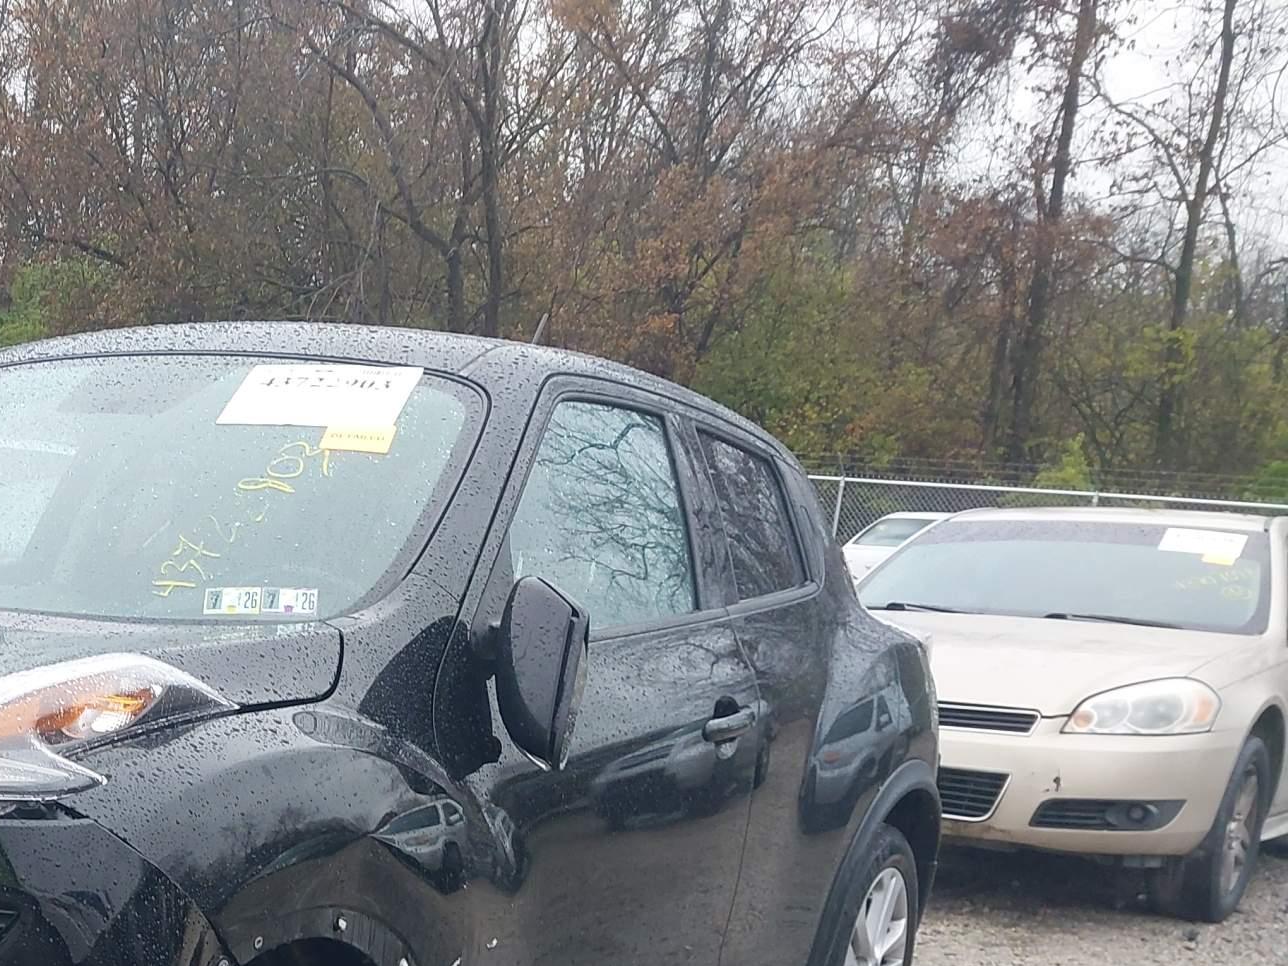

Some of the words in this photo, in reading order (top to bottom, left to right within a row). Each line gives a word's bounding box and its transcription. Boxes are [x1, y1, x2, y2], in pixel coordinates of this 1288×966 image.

[210, 590, 221, 609] 7
[267, 591, 277, 609] 7
[301, 591, 315, 610] 26
